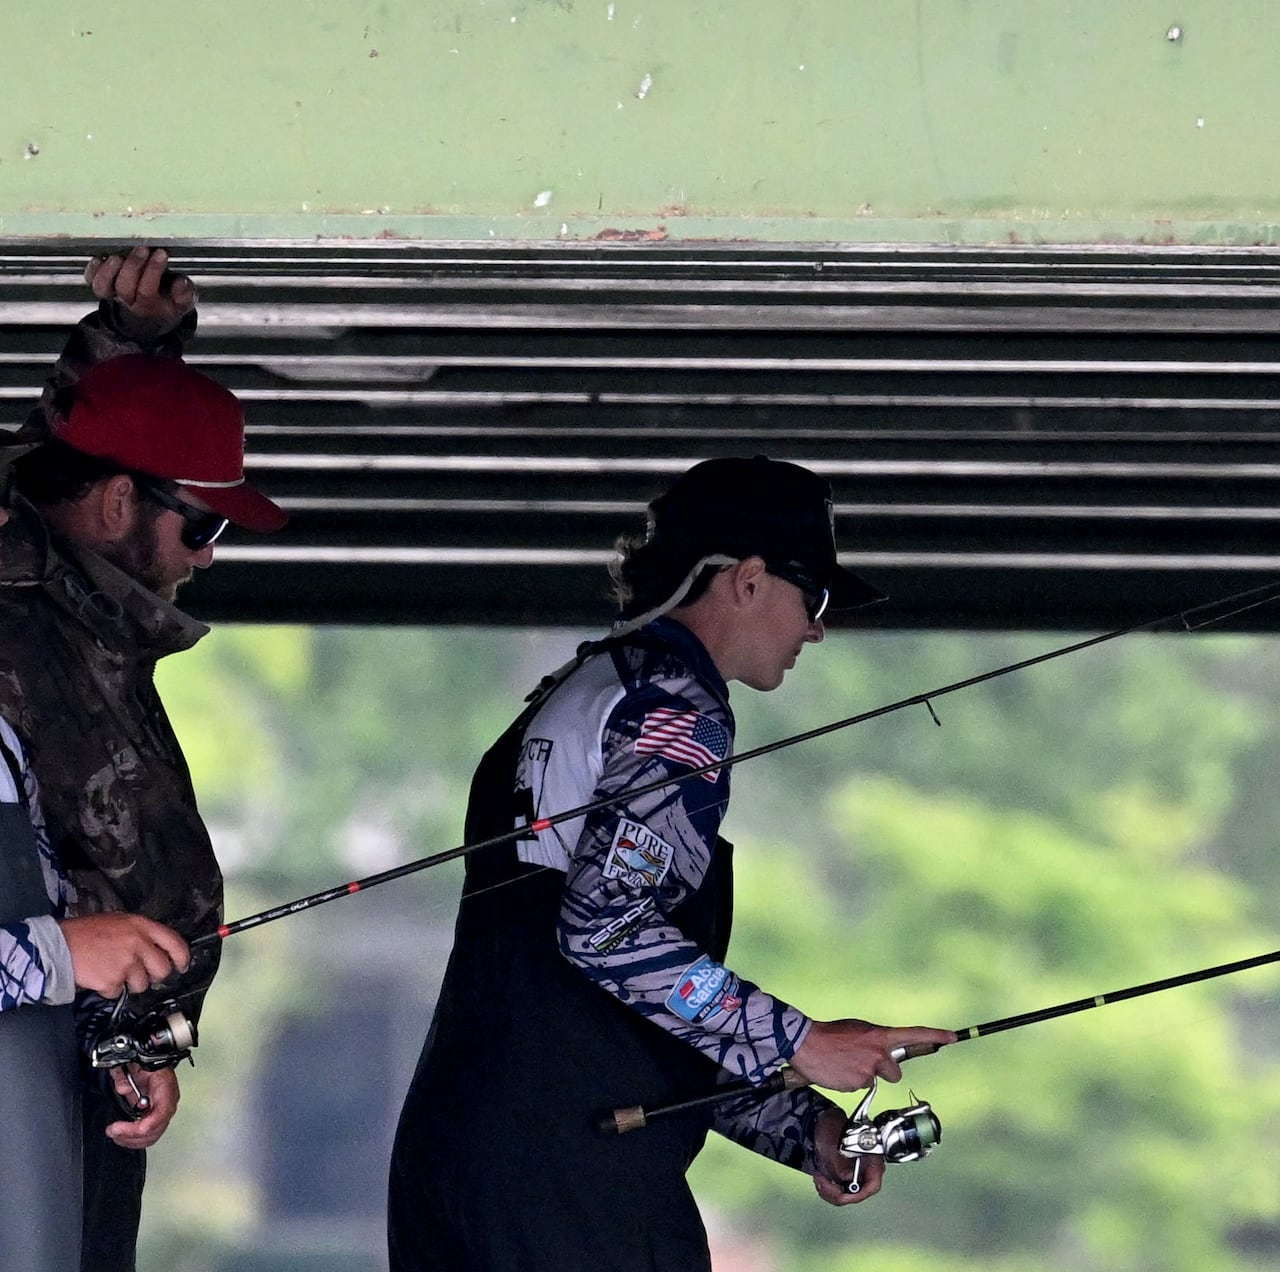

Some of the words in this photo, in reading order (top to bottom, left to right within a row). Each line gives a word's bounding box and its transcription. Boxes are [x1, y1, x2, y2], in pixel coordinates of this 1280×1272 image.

[622, 822, 669, 861] PURE
[589, 895, 657, 947] SPRO
[685, 967, 726, 1009] Garcia
